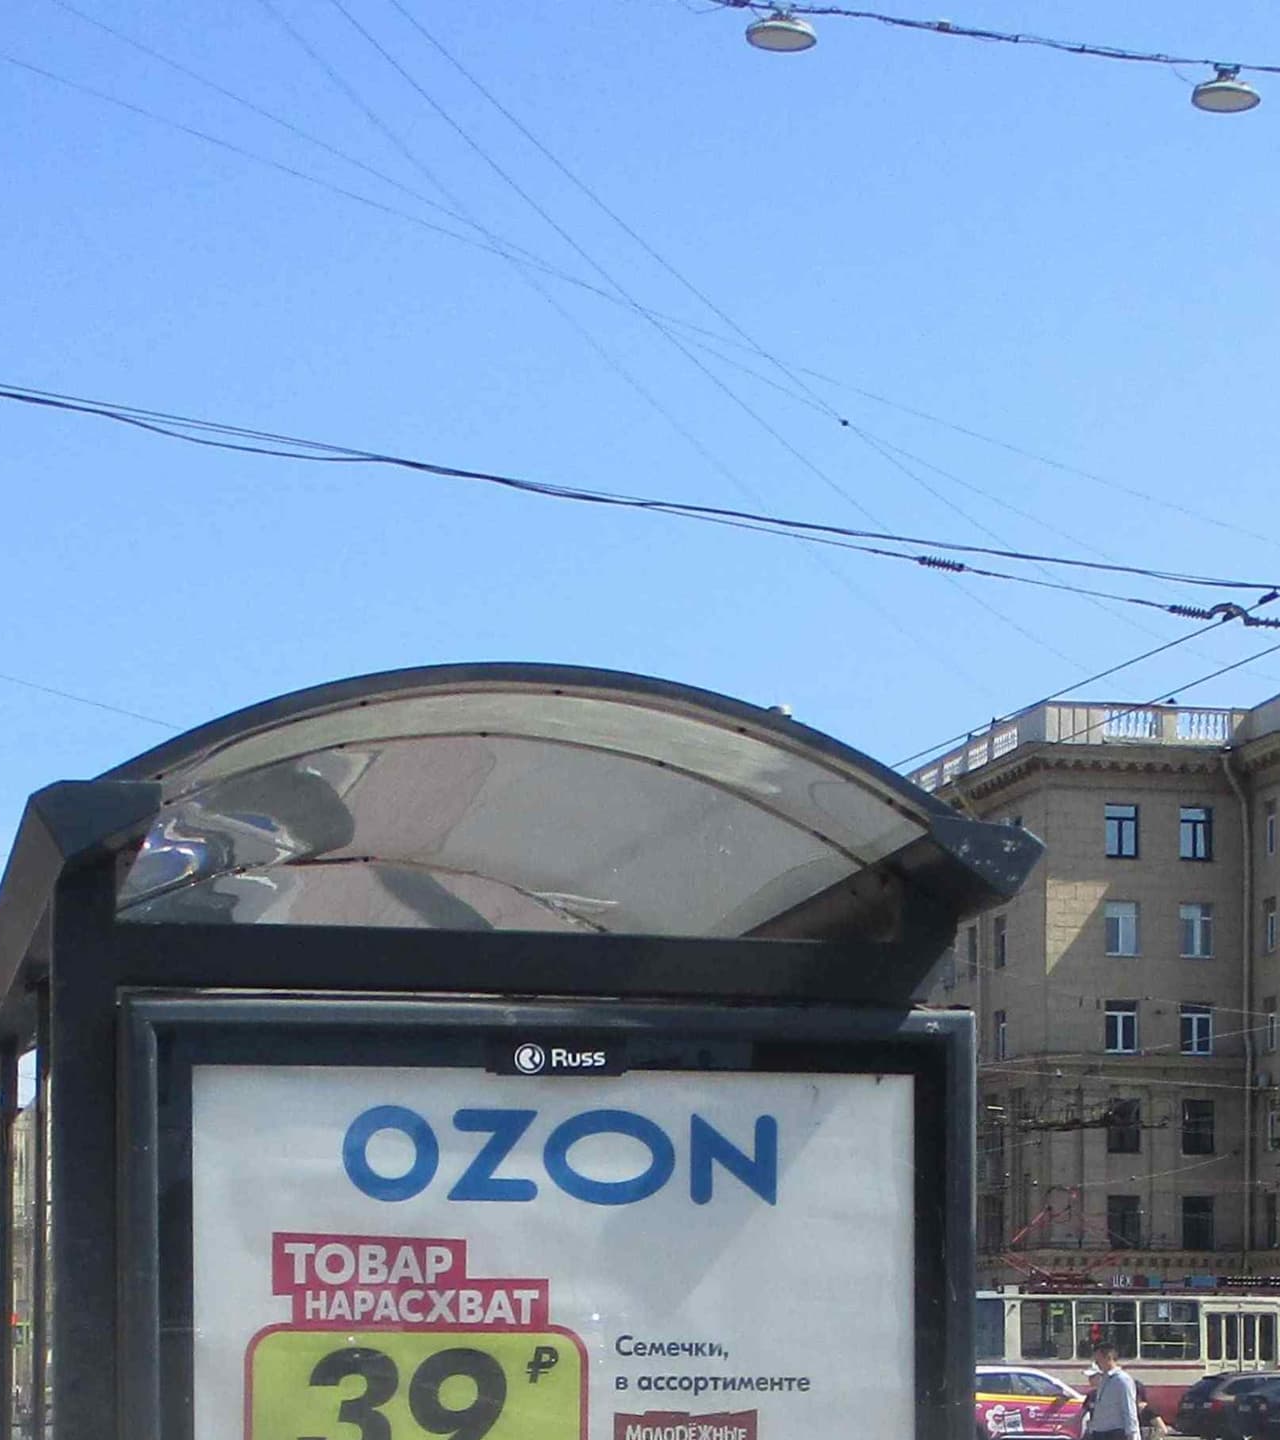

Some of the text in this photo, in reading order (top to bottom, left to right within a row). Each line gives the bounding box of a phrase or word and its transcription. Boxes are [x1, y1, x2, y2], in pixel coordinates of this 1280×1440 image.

[551, 1048, 606, 1068] Russ
[342, 1104, 778, 1206] OZON
[283, 1242, 454, 1285] ТОВАР
[305, 1289, 540, 1325] НАРАСХВАТ
[615, 1335, 729, 1360] Семечки,
[615, 1375, 811, 1396] в ассортименте
